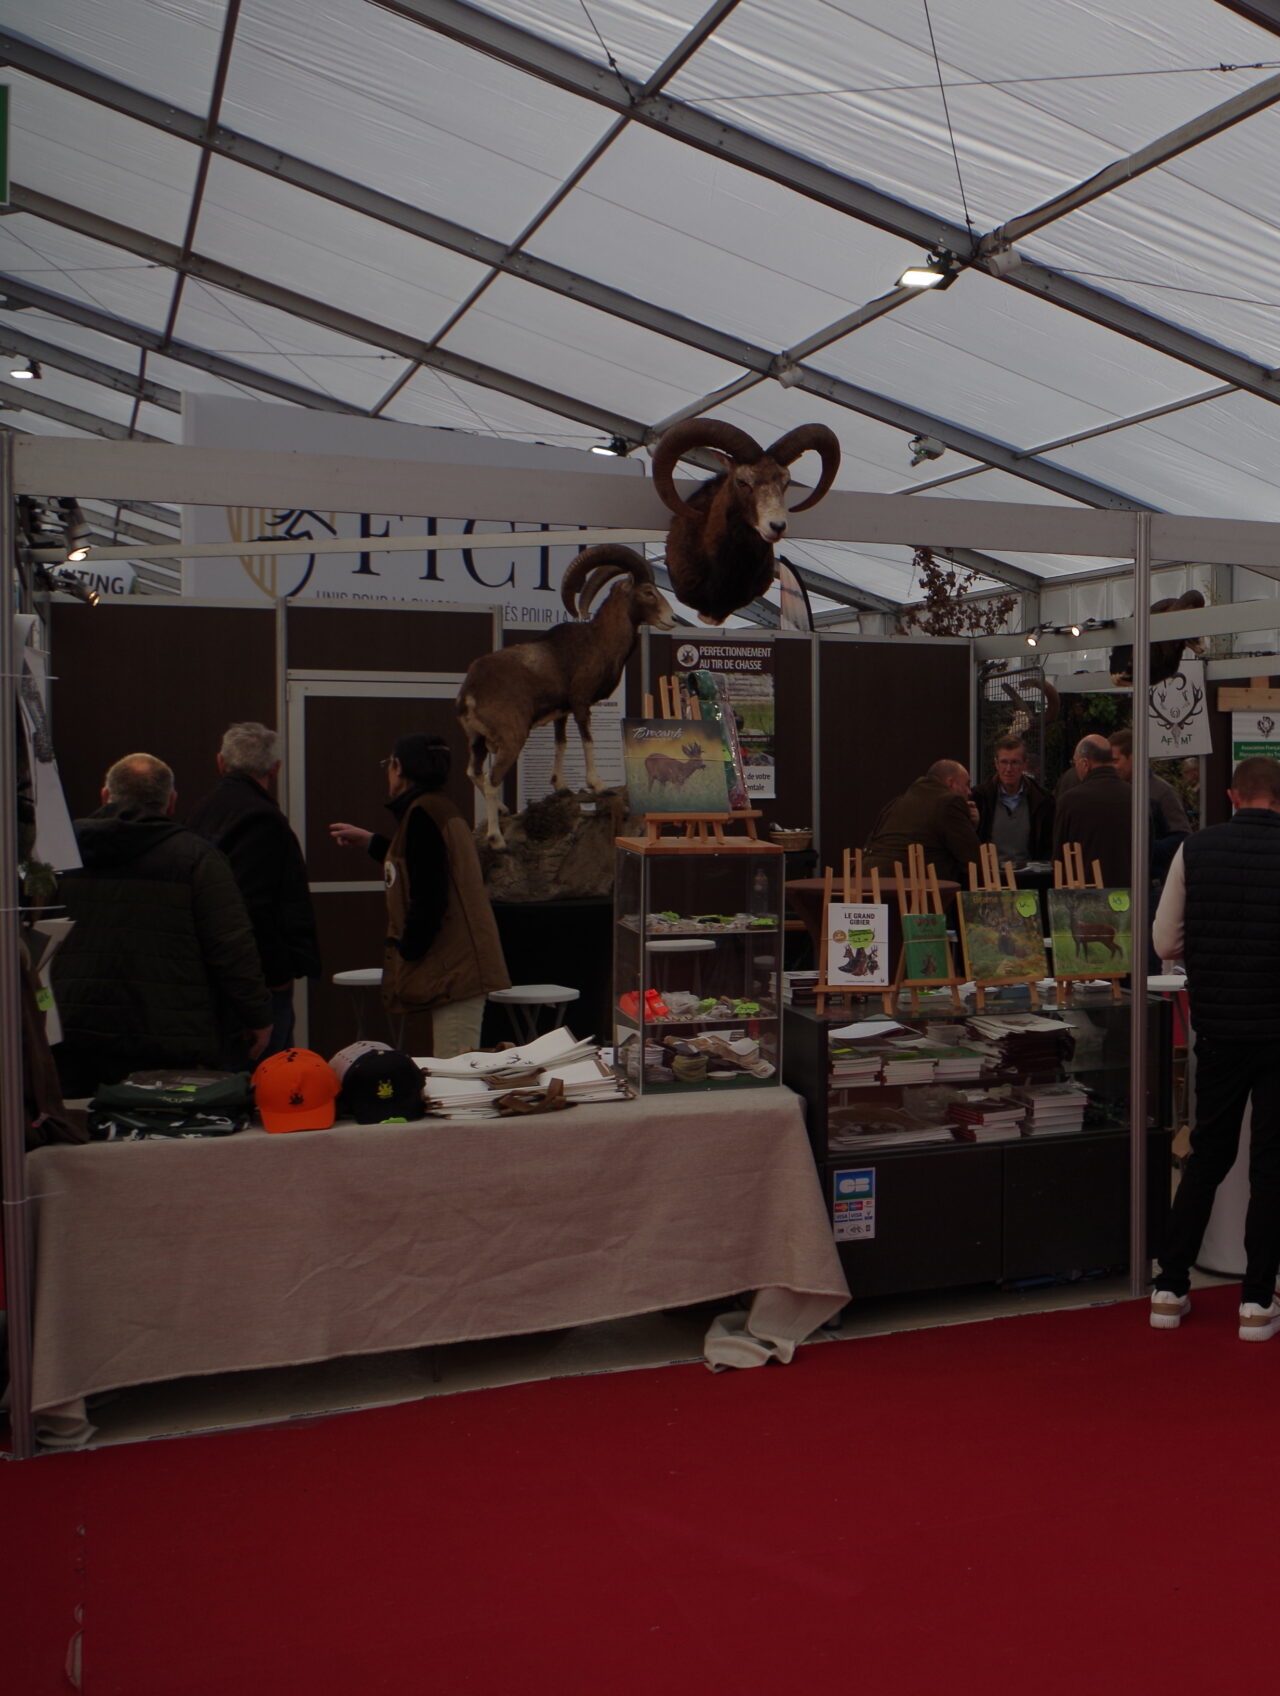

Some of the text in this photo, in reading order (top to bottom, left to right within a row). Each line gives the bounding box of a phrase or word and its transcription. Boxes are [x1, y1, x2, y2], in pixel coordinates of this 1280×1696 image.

[699, 646, 772, 658] PERFECTIONNEMENT
[699, 659, 763, 670] AU TIR DE CHASSE
[746, 772, 755, 780] de
